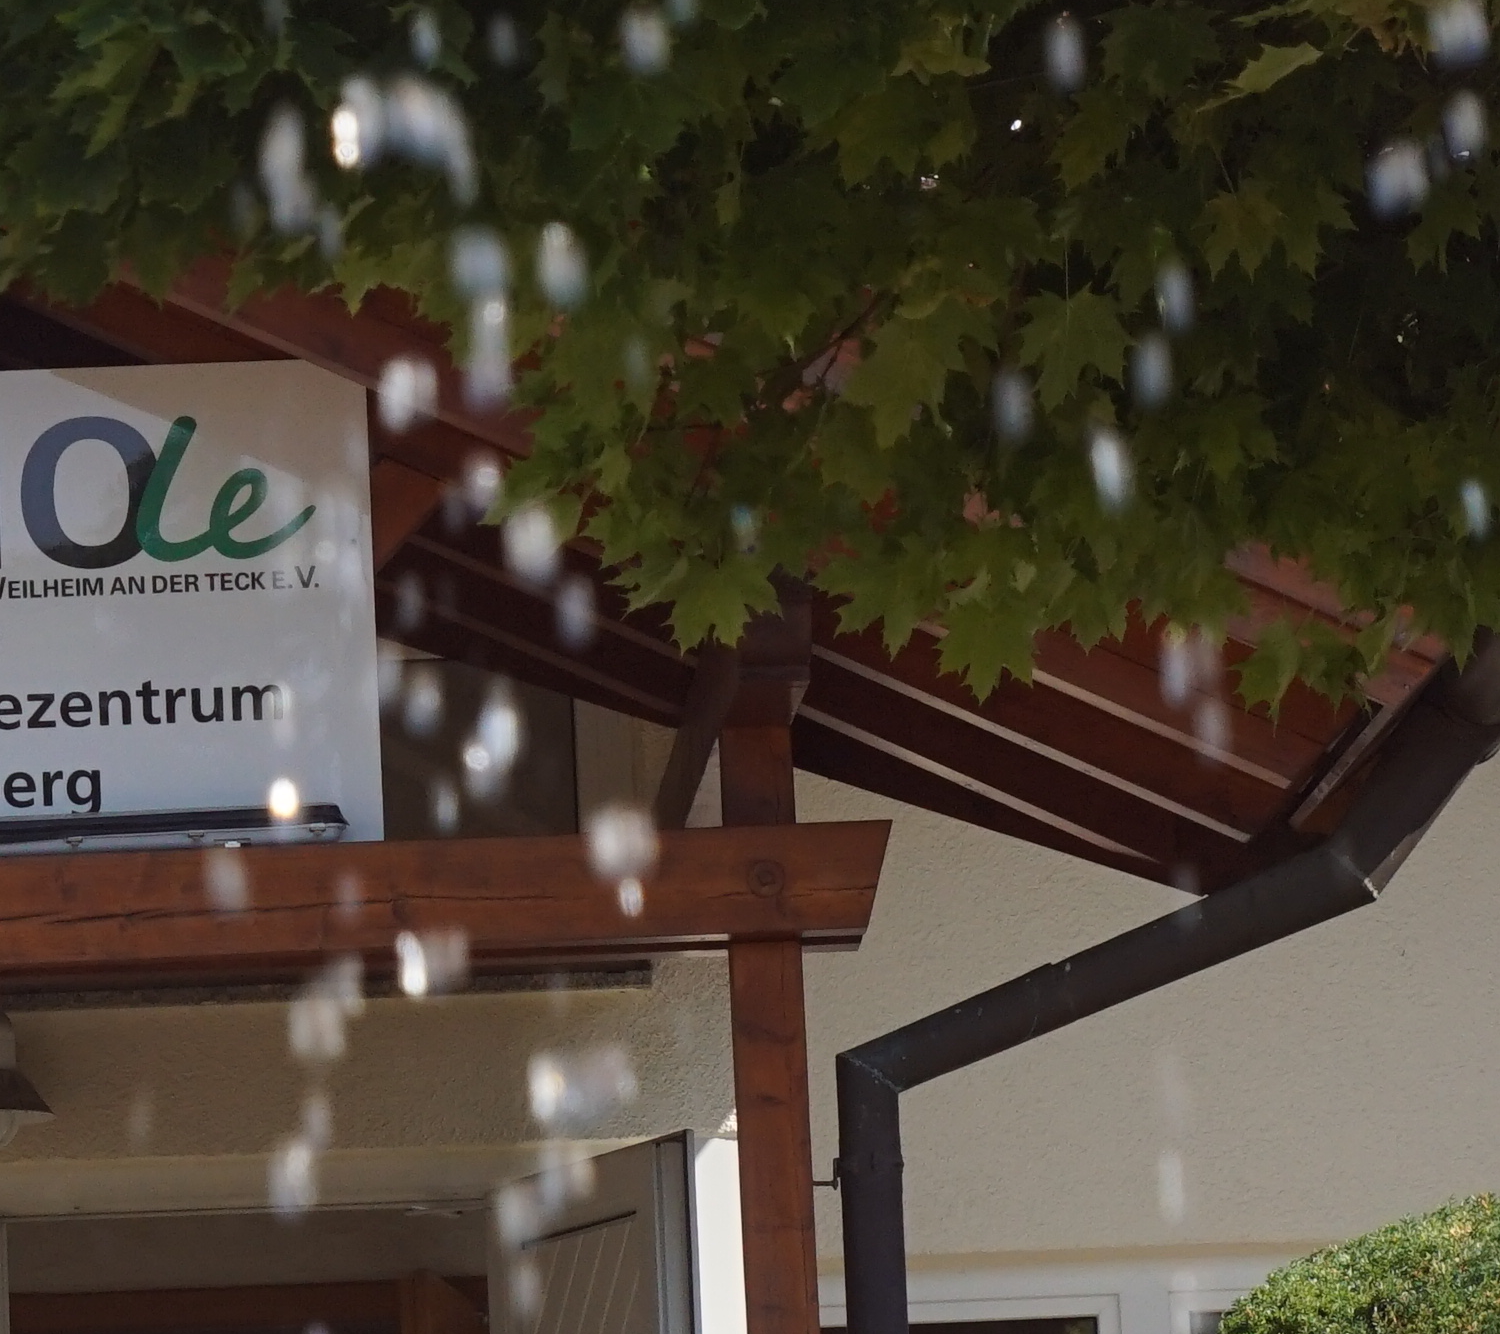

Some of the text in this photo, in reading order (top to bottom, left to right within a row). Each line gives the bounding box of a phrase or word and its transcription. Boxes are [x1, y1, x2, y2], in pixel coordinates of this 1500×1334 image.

[110, 575, 146, 596] AN
[151, 573, 200, 595] DER
[204, 571, 266, 592] TECK
